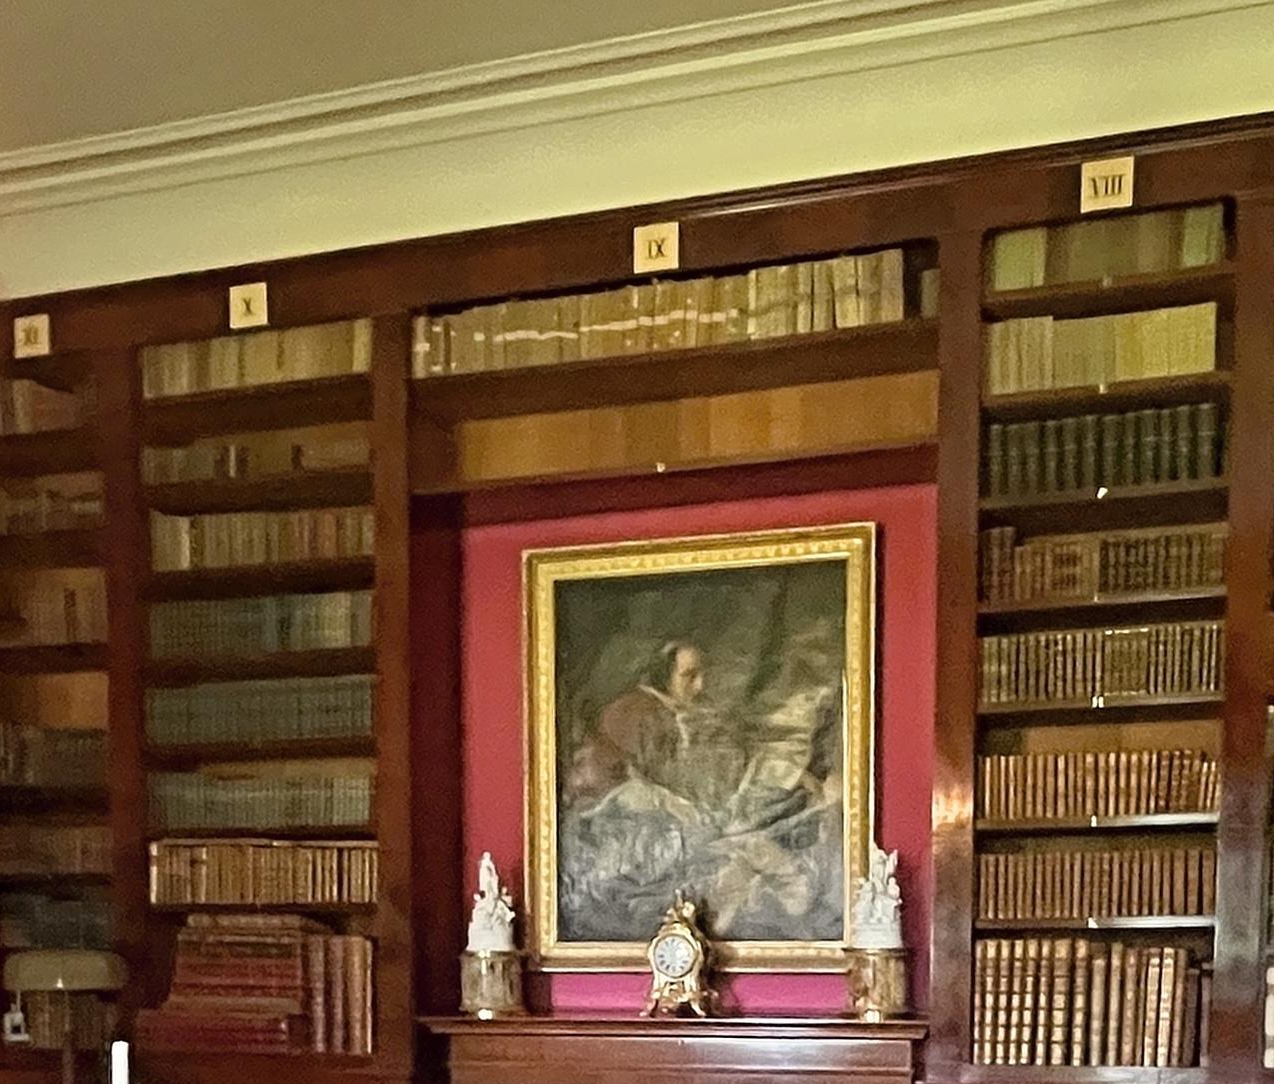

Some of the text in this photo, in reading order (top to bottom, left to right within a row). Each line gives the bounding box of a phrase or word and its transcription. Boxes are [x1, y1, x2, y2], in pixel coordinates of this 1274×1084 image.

[1087, 174, 1125, 198] VIII
[646, 238, 666, 260] IX
[241, 297, 255, 317] X
